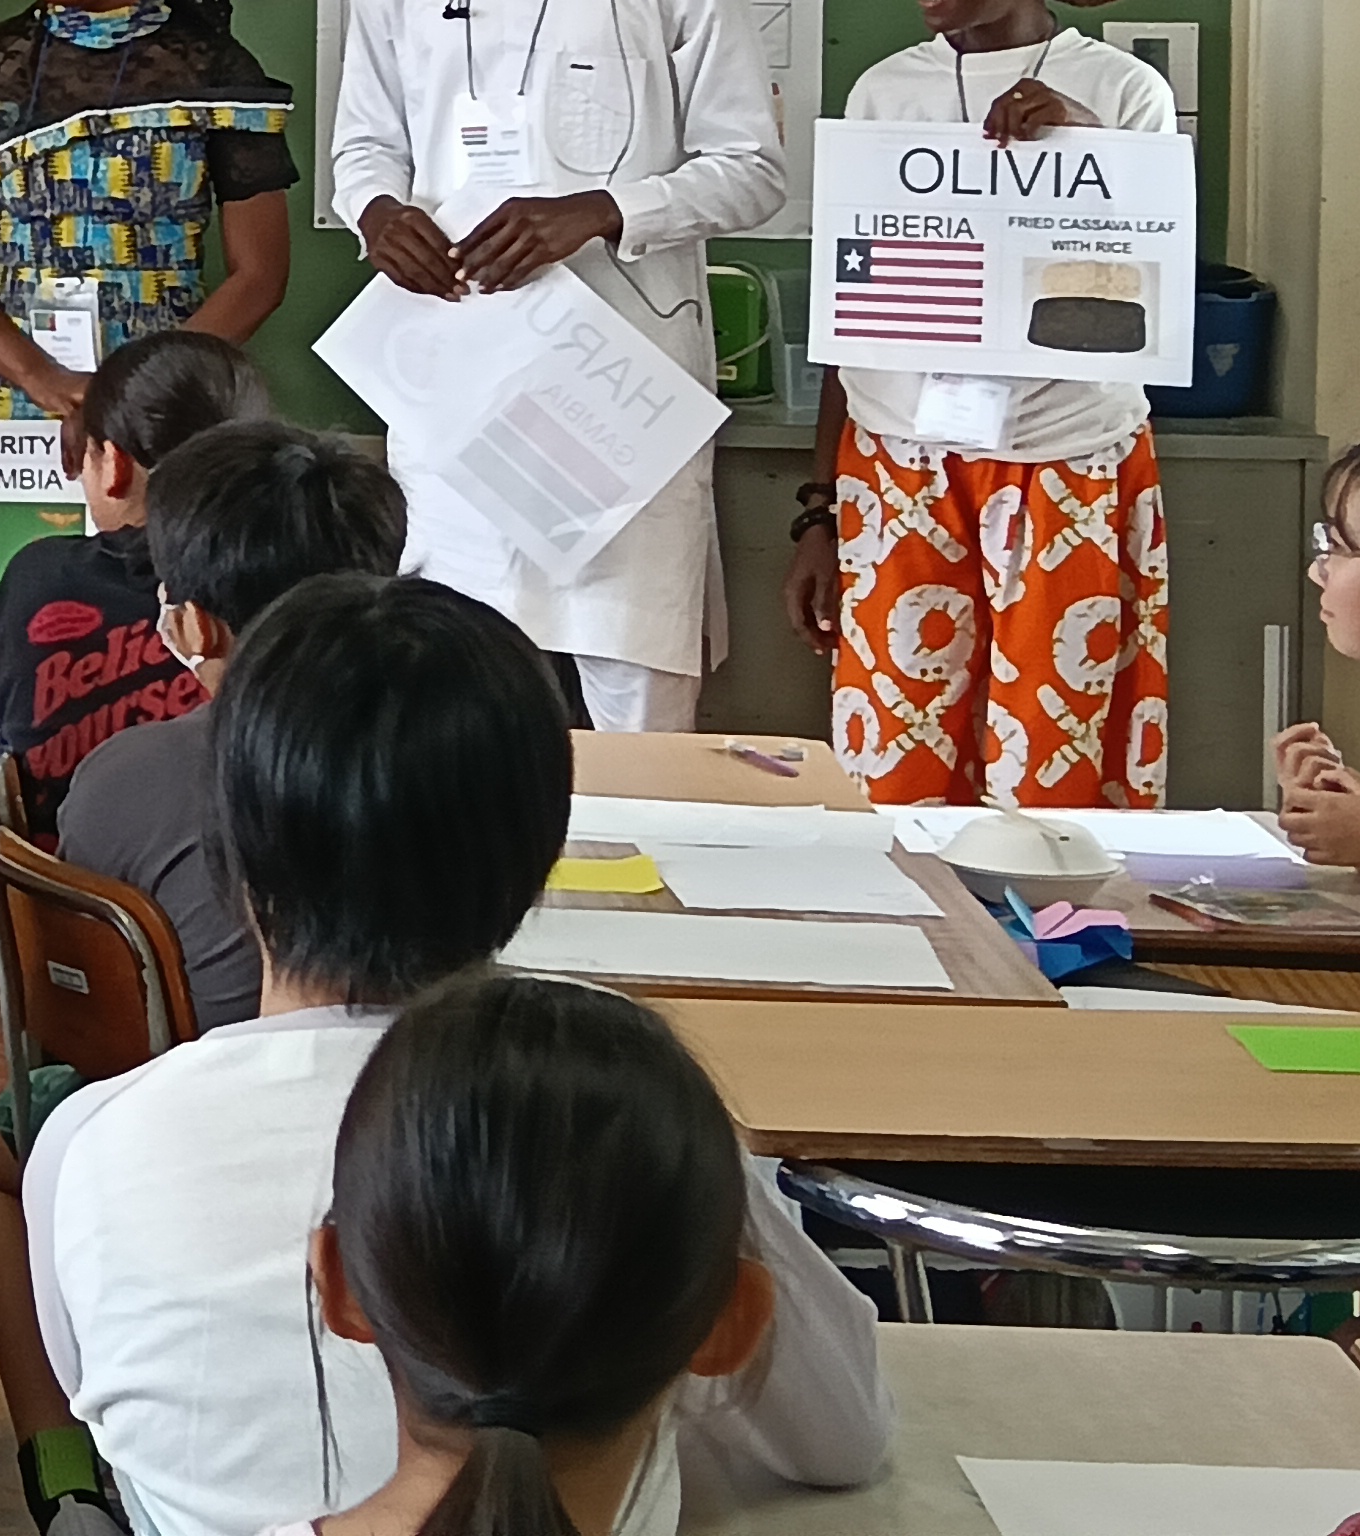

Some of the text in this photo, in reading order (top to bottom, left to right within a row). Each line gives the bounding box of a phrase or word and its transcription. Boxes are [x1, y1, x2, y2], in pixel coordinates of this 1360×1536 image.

[899, 147, 1112, 200] OLIVIA
[854, 213, 975, 239] LIBERIA
[1008, 217, 1177, 234] FRIED CASSAVA LEAF
[1052, 240, 1134, 255] WITH RICE
